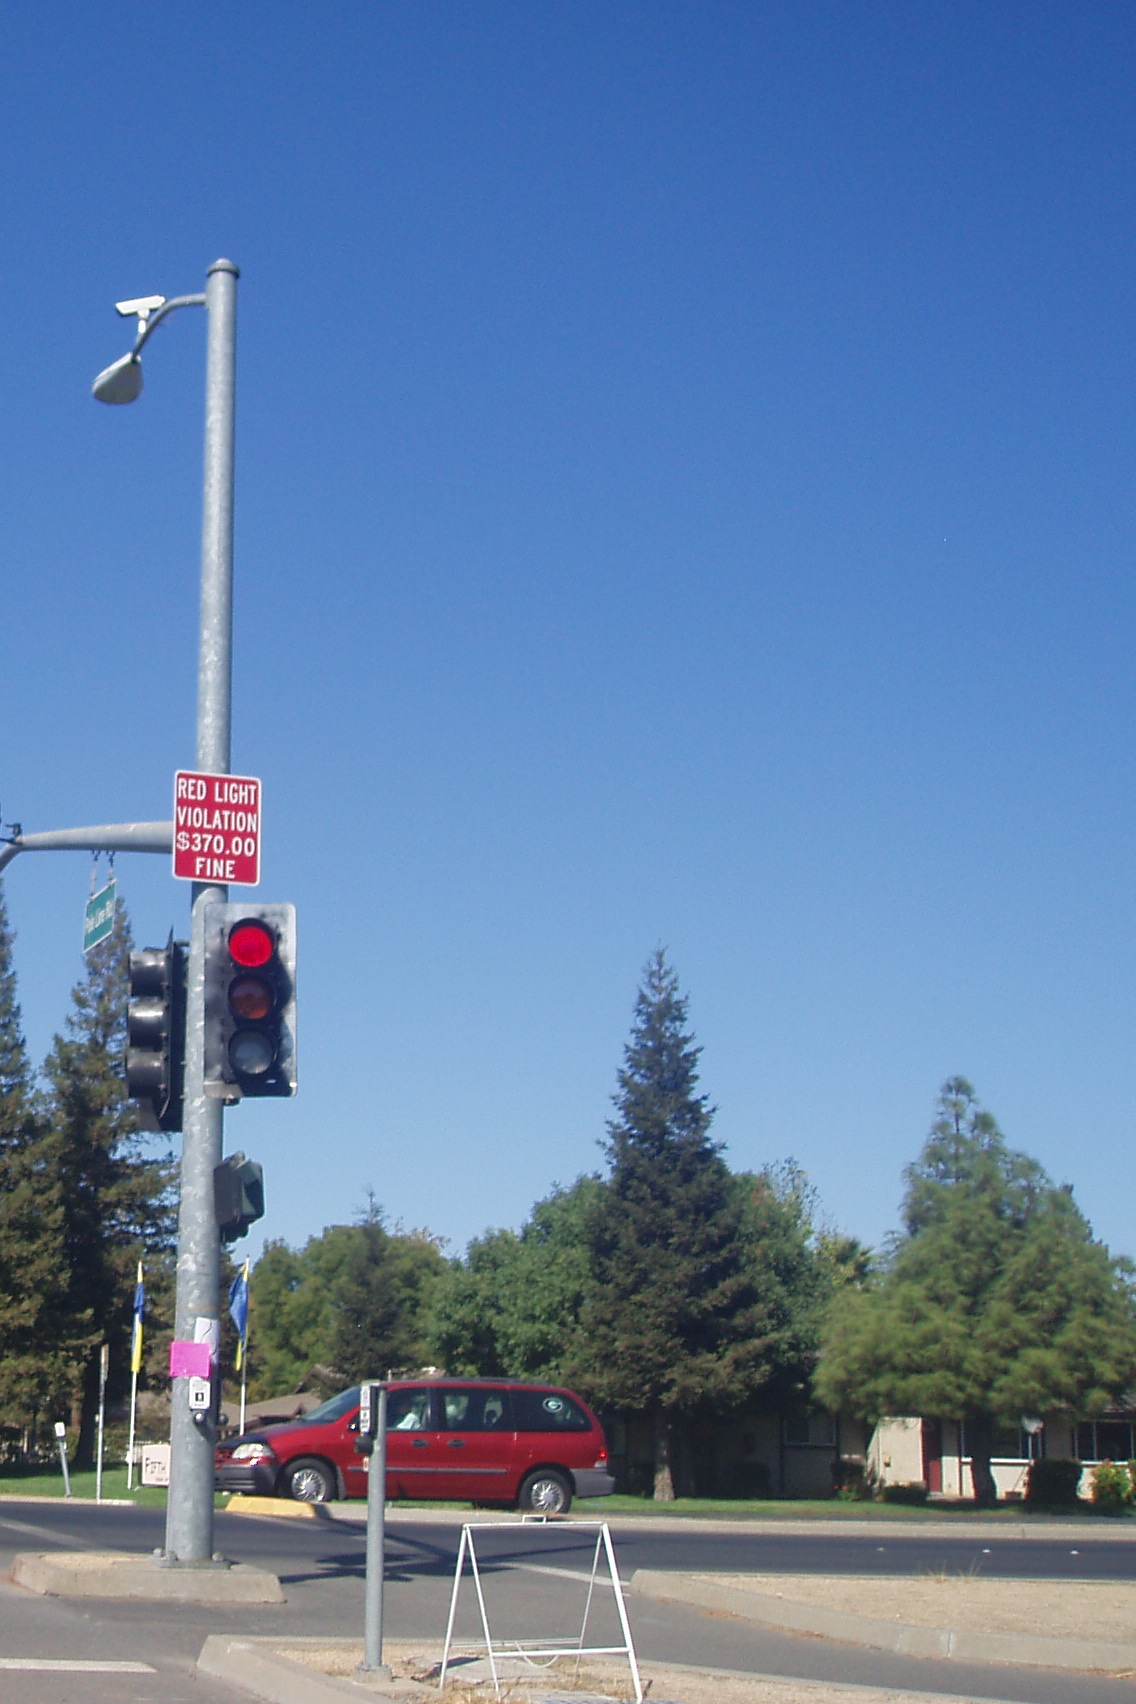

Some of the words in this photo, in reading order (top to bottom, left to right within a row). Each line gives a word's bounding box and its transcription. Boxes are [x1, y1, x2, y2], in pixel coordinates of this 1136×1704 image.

[177, 778, 207, 801] RED
[214, 782, 258, 806] LIGHT
[176, 805, 258, 834] VIOLATION
[176, 831, 256, 858] $370.00
[195, 857, 236, 879] FINE
